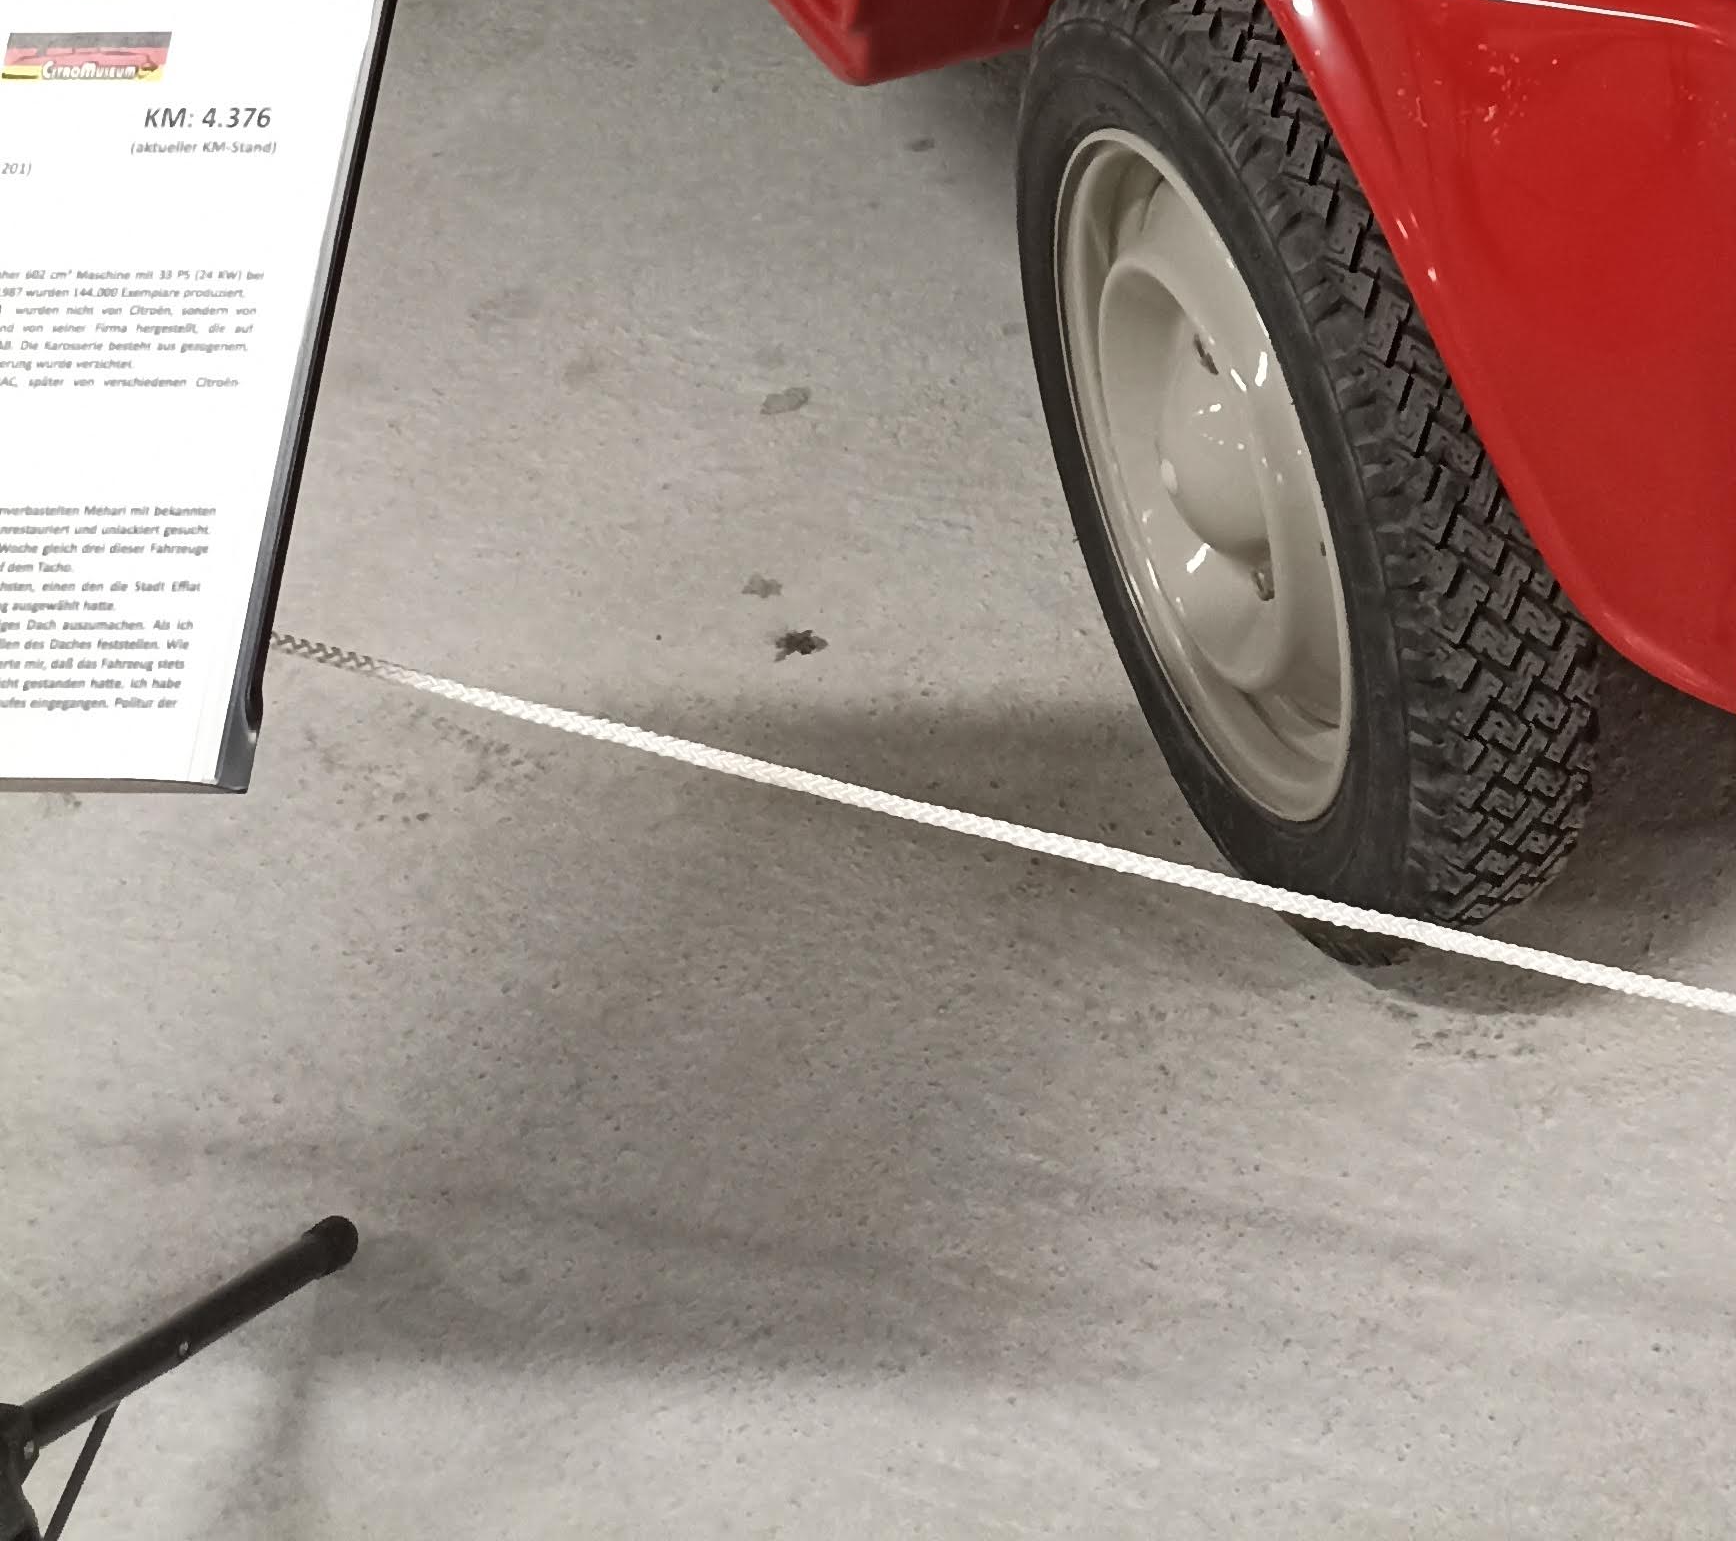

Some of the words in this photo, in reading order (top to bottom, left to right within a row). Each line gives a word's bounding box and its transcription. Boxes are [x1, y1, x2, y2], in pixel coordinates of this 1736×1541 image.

[144, 107, 194, 129] KM:
[201, 106, 272, 129] 4.376
[130, 140, 198, 155] (aktueller
[202, 141, 277, 155] KM-Stand)
[76, 270, 131, 280] Maschine
[26, 288, 70, 298] wurden
[121, 287, 180, 299] Exemplare
[16, 305, 60, 316] wurden
[66, 305, 95, 316] nicht
[102, 307, 122, 316] von
[182, 306, 229, 316] sondern
[236, 307, 257, 316] von
[23, 324, 44, 334] von
[96, 322, 128, 334] Firma
[235, 323, 254, 334] auf
[21, 340, 39, 351] Die
[44, 340, 104, 352] Karosserie
[157, 342, 176, 352] aus
[36, 359, 73, 370] wurde
[28, 375, 65, 389] später
[73, 378, 95, 387] von
[104, 377, 187, 388] verschiedenen
[130, 505, 150, 516] mit
[154, 505, 217, 517] bekannten
[74, 524, 98, 535] und
[150, 542, 209, 557] Fahrzeuge
[109, 580, 129, 593] die
[134, 580, 166, 593] Stadt
[171, 580, 201, 593] Effiat
[26, 618, 57, 631] Dach
[152, 619, 171, 631] Als
[24, 639, 45, 651] des
[50, 638, 93, 650] Daches
[77, 657, 98, 670] das
[101, 657, 155, 673] Fahrzeug
[158, 659, 185, 670] stets
[22, 677, 86, 692] gestanden
[151, 677, 182, 690] habe
